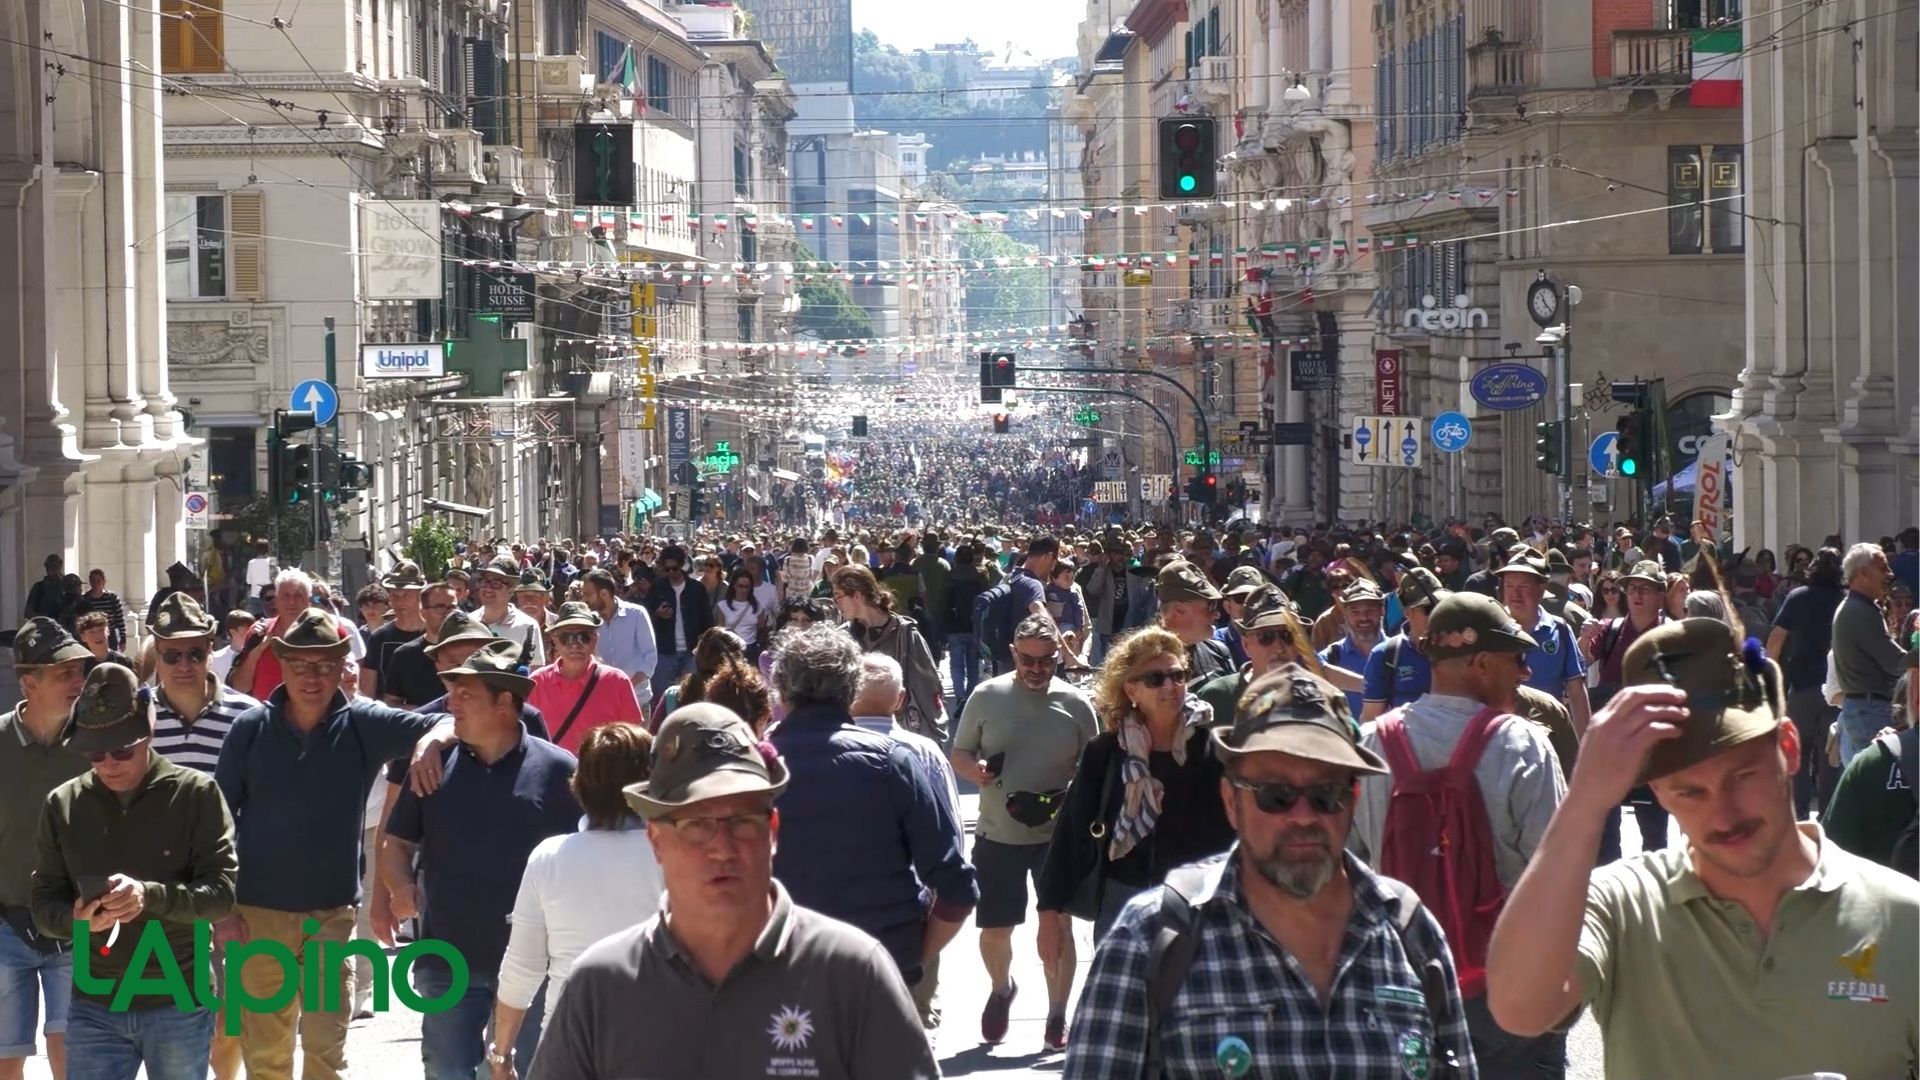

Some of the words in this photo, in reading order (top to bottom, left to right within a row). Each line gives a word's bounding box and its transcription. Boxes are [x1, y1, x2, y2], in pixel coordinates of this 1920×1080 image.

[1719, 165, 1731, 180] F
[375, 212, 430, 231] HOTEL
[370, 237, 436, 254] GENOVA
[489, 284, 526, 295] HOTEL
[489, 295, 526, 306] SUISSE
[377, 350, 429, 371] Unipol
[675, 411, 685, 440] MOG
[1185, 452, 1220, 464] SOLRI
